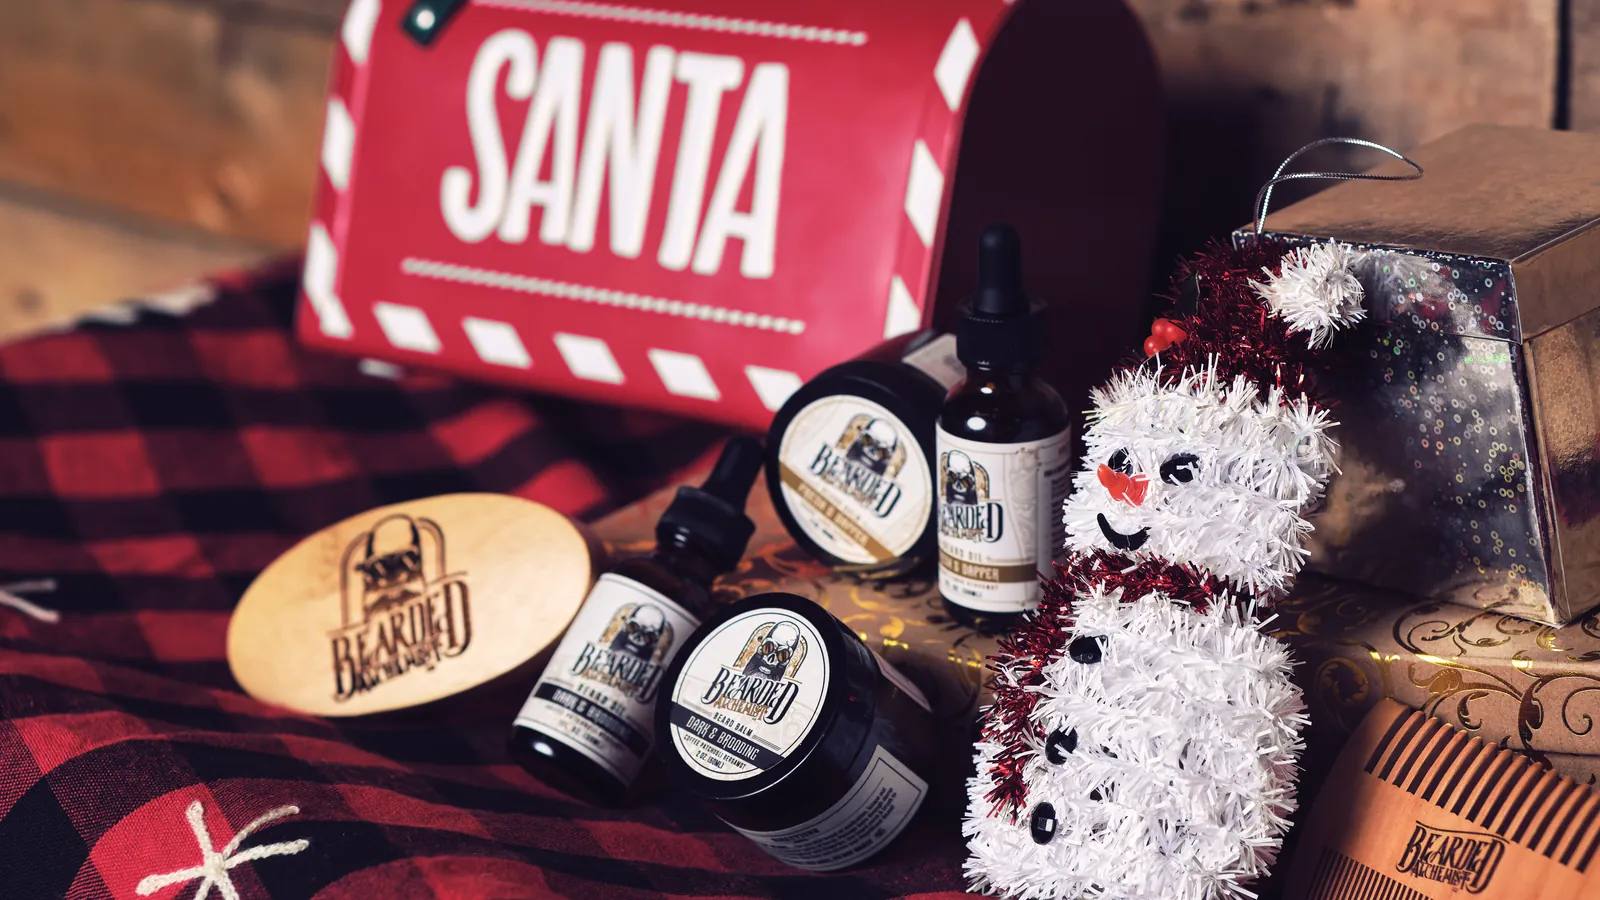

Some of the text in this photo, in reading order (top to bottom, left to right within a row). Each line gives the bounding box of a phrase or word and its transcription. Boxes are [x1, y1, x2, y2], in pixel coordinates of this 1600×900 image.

[439, 28, 790, 279] SANTA
[810, 443, 902, 518] BEARDED
[331, 579, 472, 703] BEARDED
[569, 642, 663, 705] BEARDED
[701, 667, 799, 725] BEARDED
[713, 696, 768, 721] ALCHEMIST
[713, 712, 753, 736] BEARD BALM
[684, 734, 747, 770] COFFEE PATCHOULI BERGAMOT
[686, 716, 760, 761] DARK & BROODING
[1395, 825, 1506, 894] BEARDED
[1410, 859, 1471, 890] ALCHEMIST
